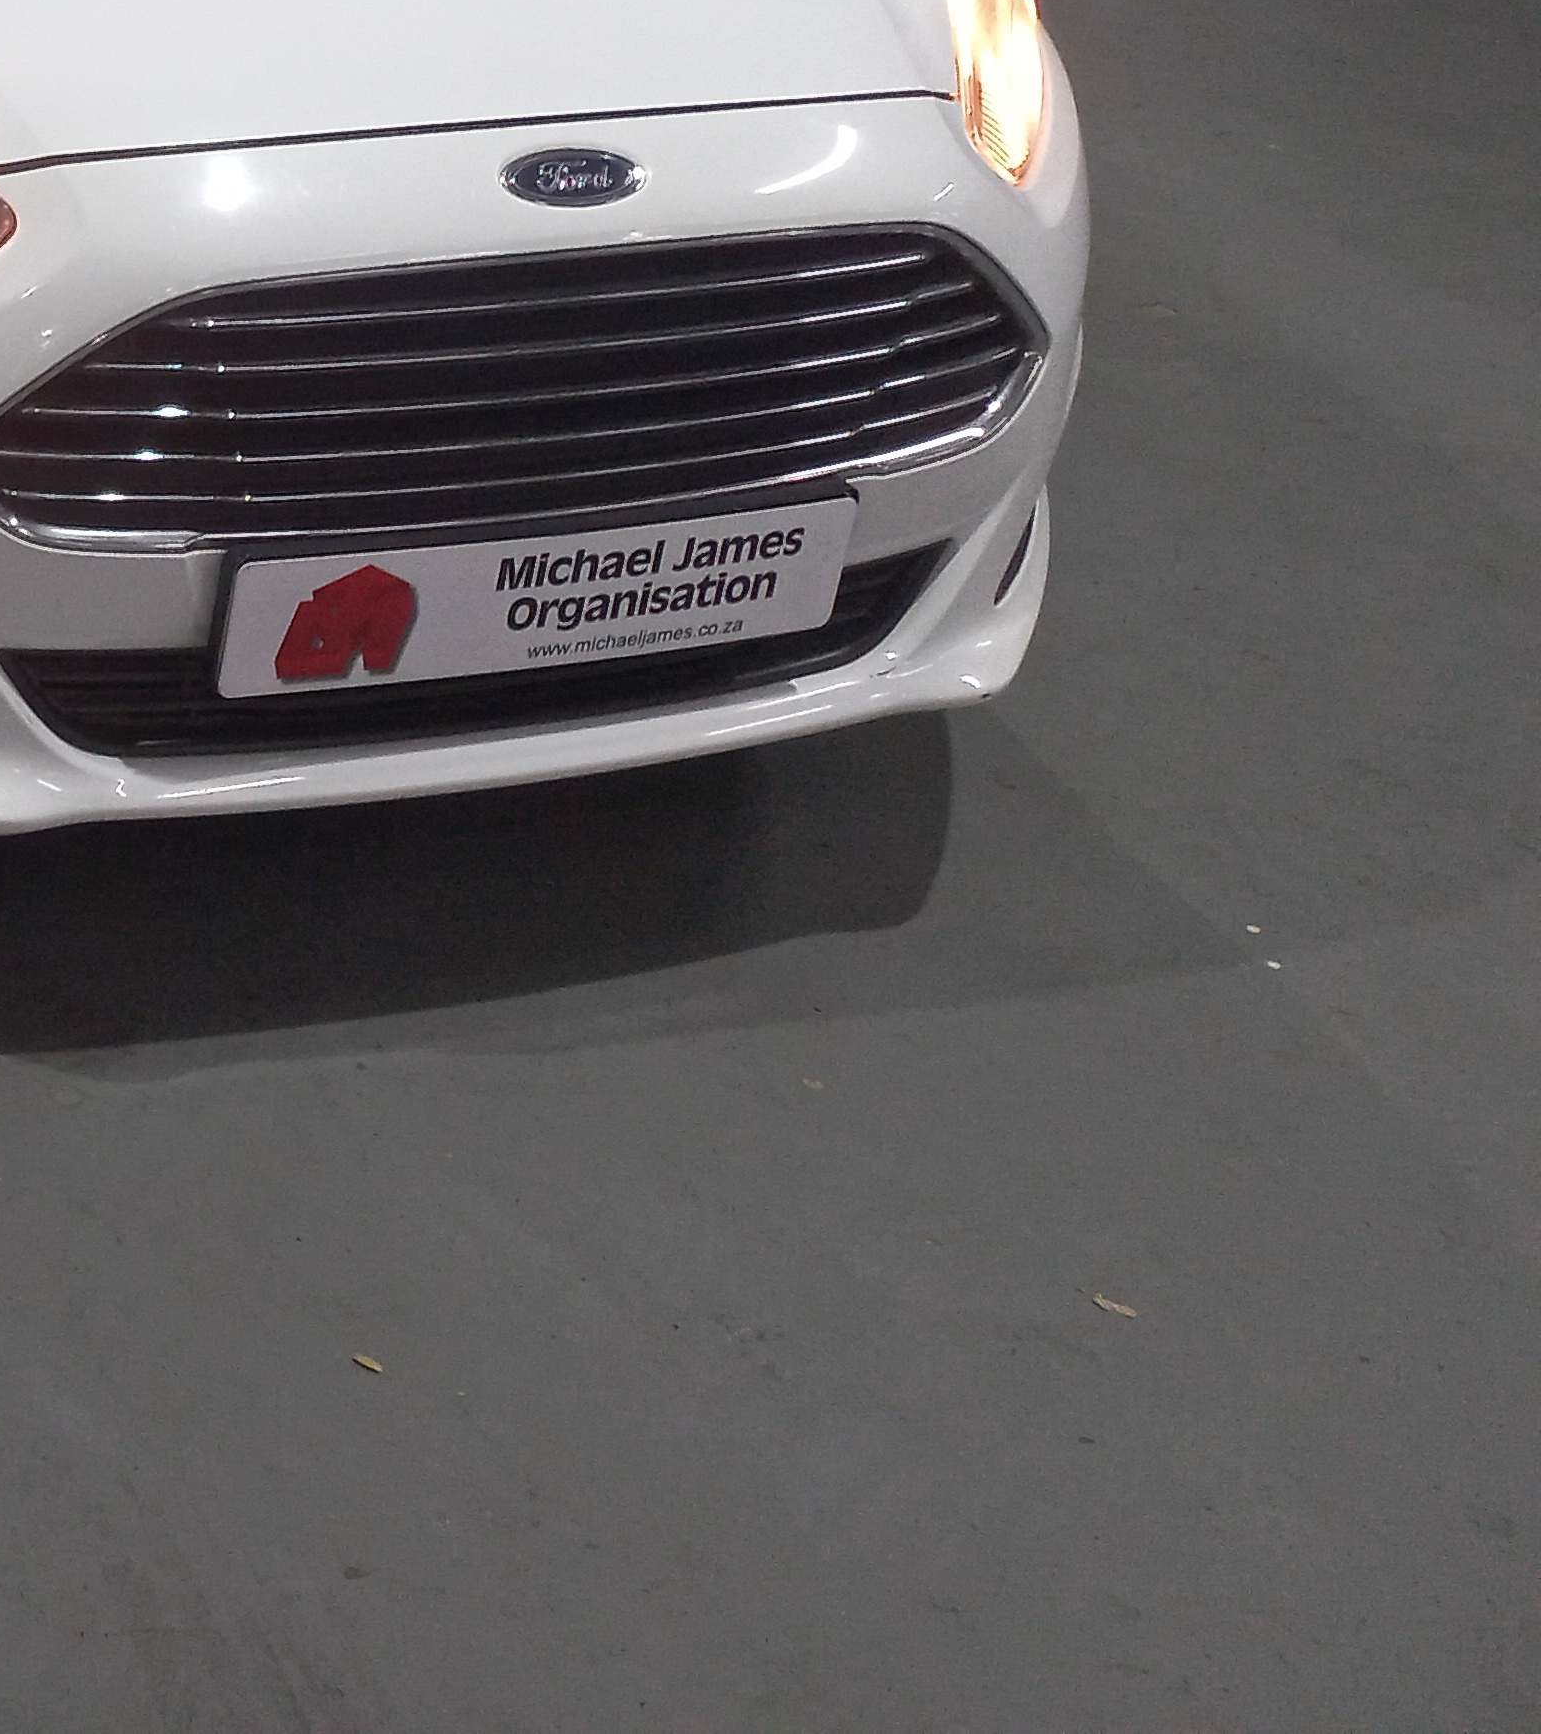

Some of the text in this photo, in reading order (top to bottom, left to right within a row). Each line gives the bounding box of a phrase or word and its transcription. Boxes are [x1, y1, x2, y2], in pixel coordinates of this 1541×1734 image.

[537, 160, 613, 194] Ford
[495, 527, 805, 592] Michael James
[507, 570, 777, 631] Organisation
[528, 619, 743, 658] www.michaeljames.co.za
